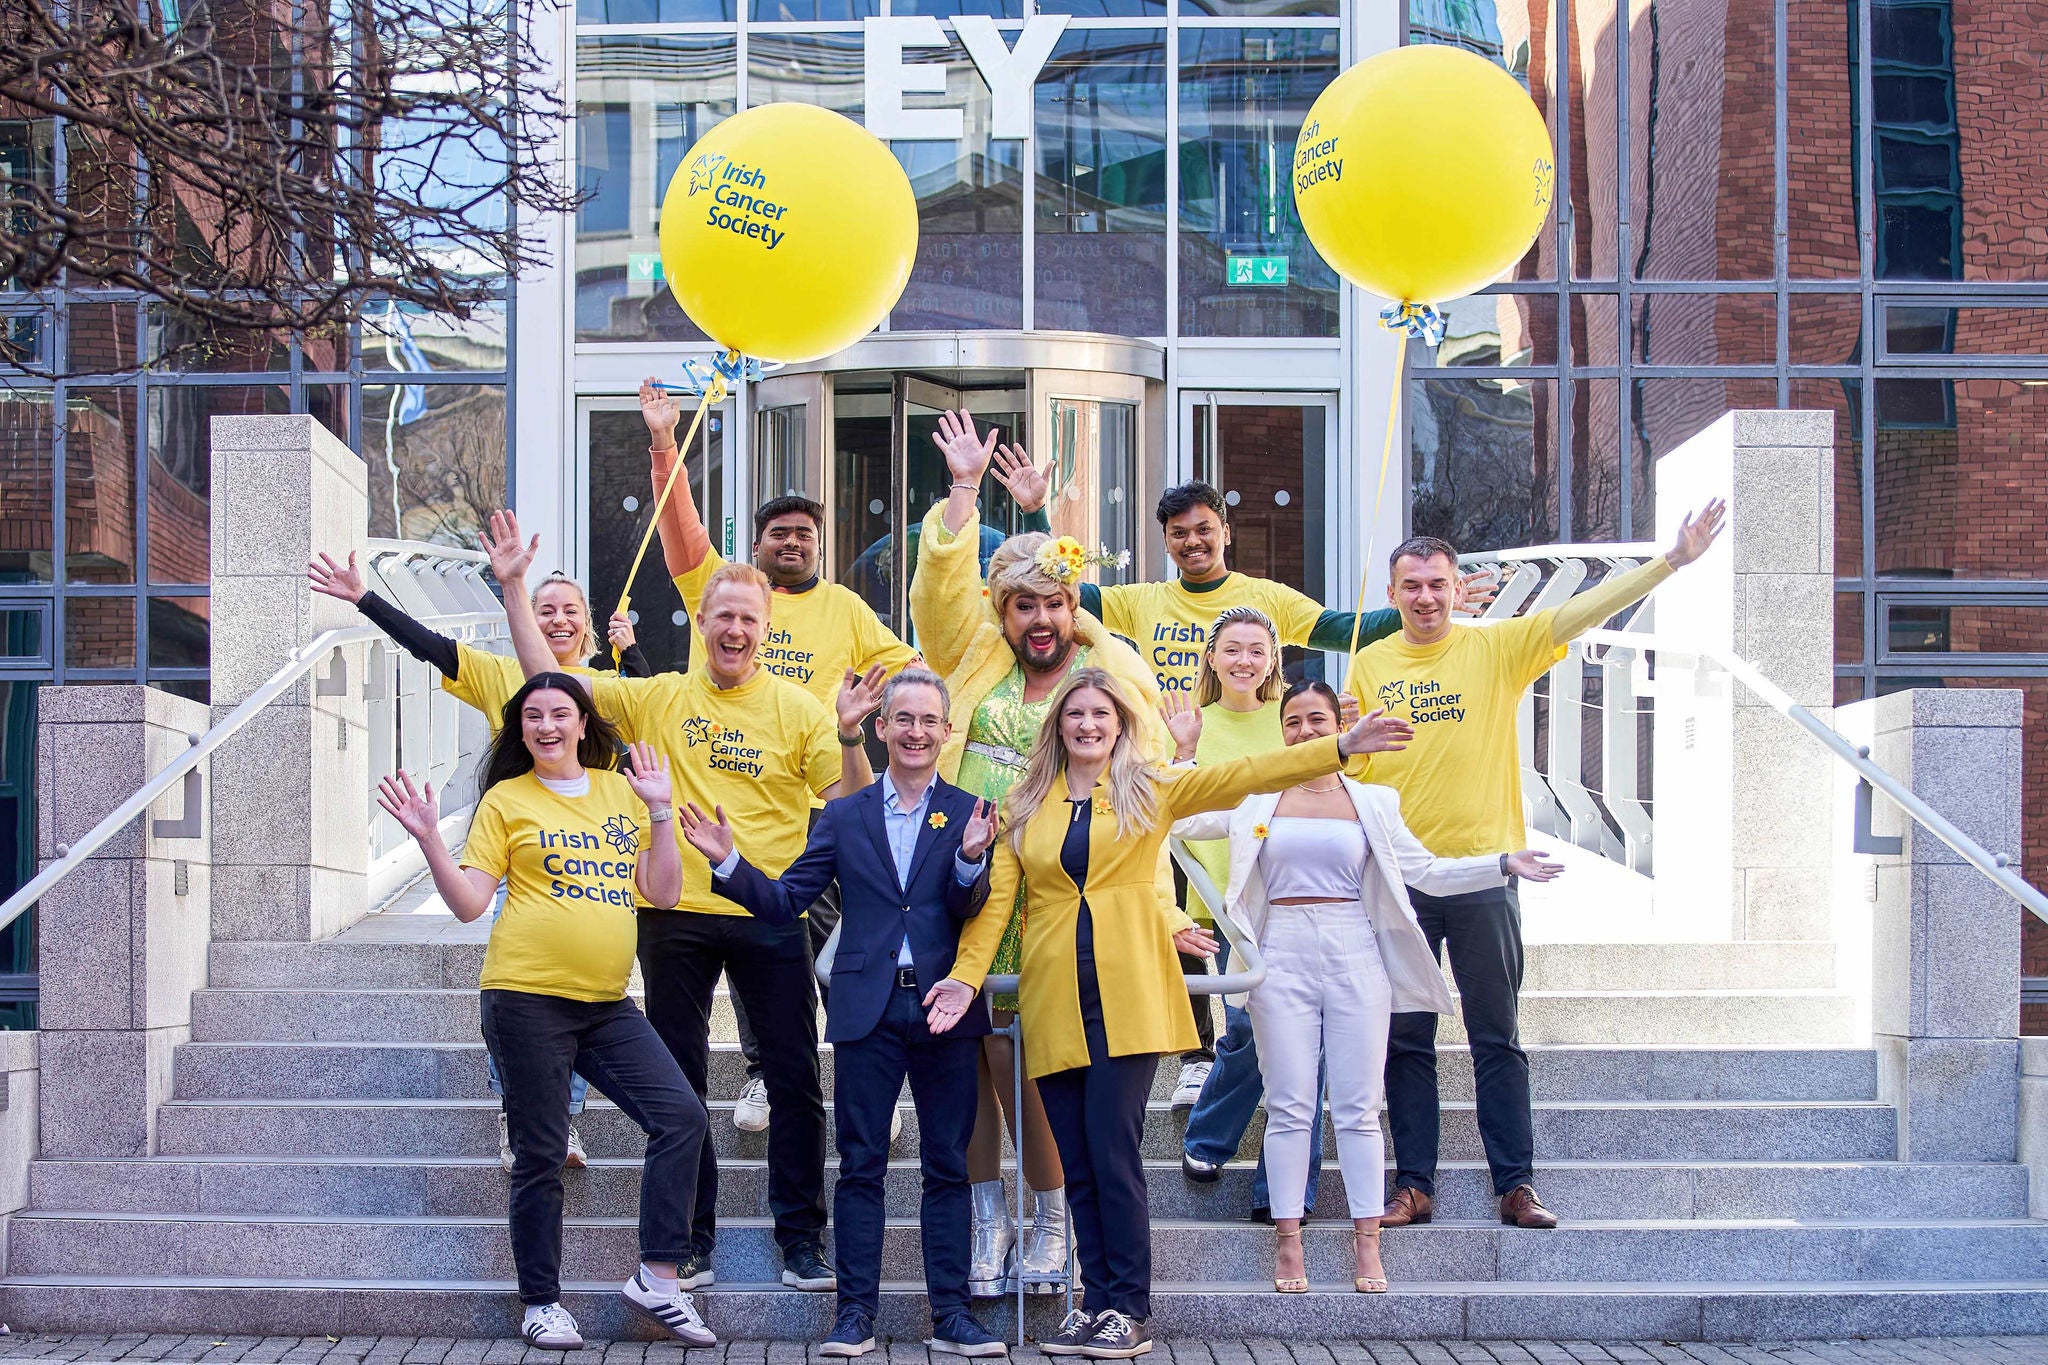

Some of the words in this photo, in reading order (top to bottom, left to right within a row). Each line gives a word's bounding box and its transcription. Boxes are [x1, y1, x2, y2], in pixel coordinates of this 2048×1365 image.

[864, 15, 1072, 140] EY
[1296, 136, 1339, 170] Cancer
[722, 161, 766, 190] Irish
[1297, 158, 1344, 194] Society
[714, 184, 788, 220] Cancer
[706, 206, 785, 250] Society
[767, 627, 792, 644] ish
[1153, 622, 1205, 643] Irish
[1153, 646, 1199, 667] Can
[756, 656, 815, 684] ciety
[1156, 671, 1198, 692] Soci
[1409, 680, 1441, 696] Irish
[1409, 693, 1462, 709] Cancer
[1410, 706, 1466, 724] Society
[712, 727, 744, 743] ish
[711, 740, 763, 759] Cancer
[708, 754, 764, 778] Society
[539, 828, 600, 850] Irish
[543, 853, 635, 880] Cancer
